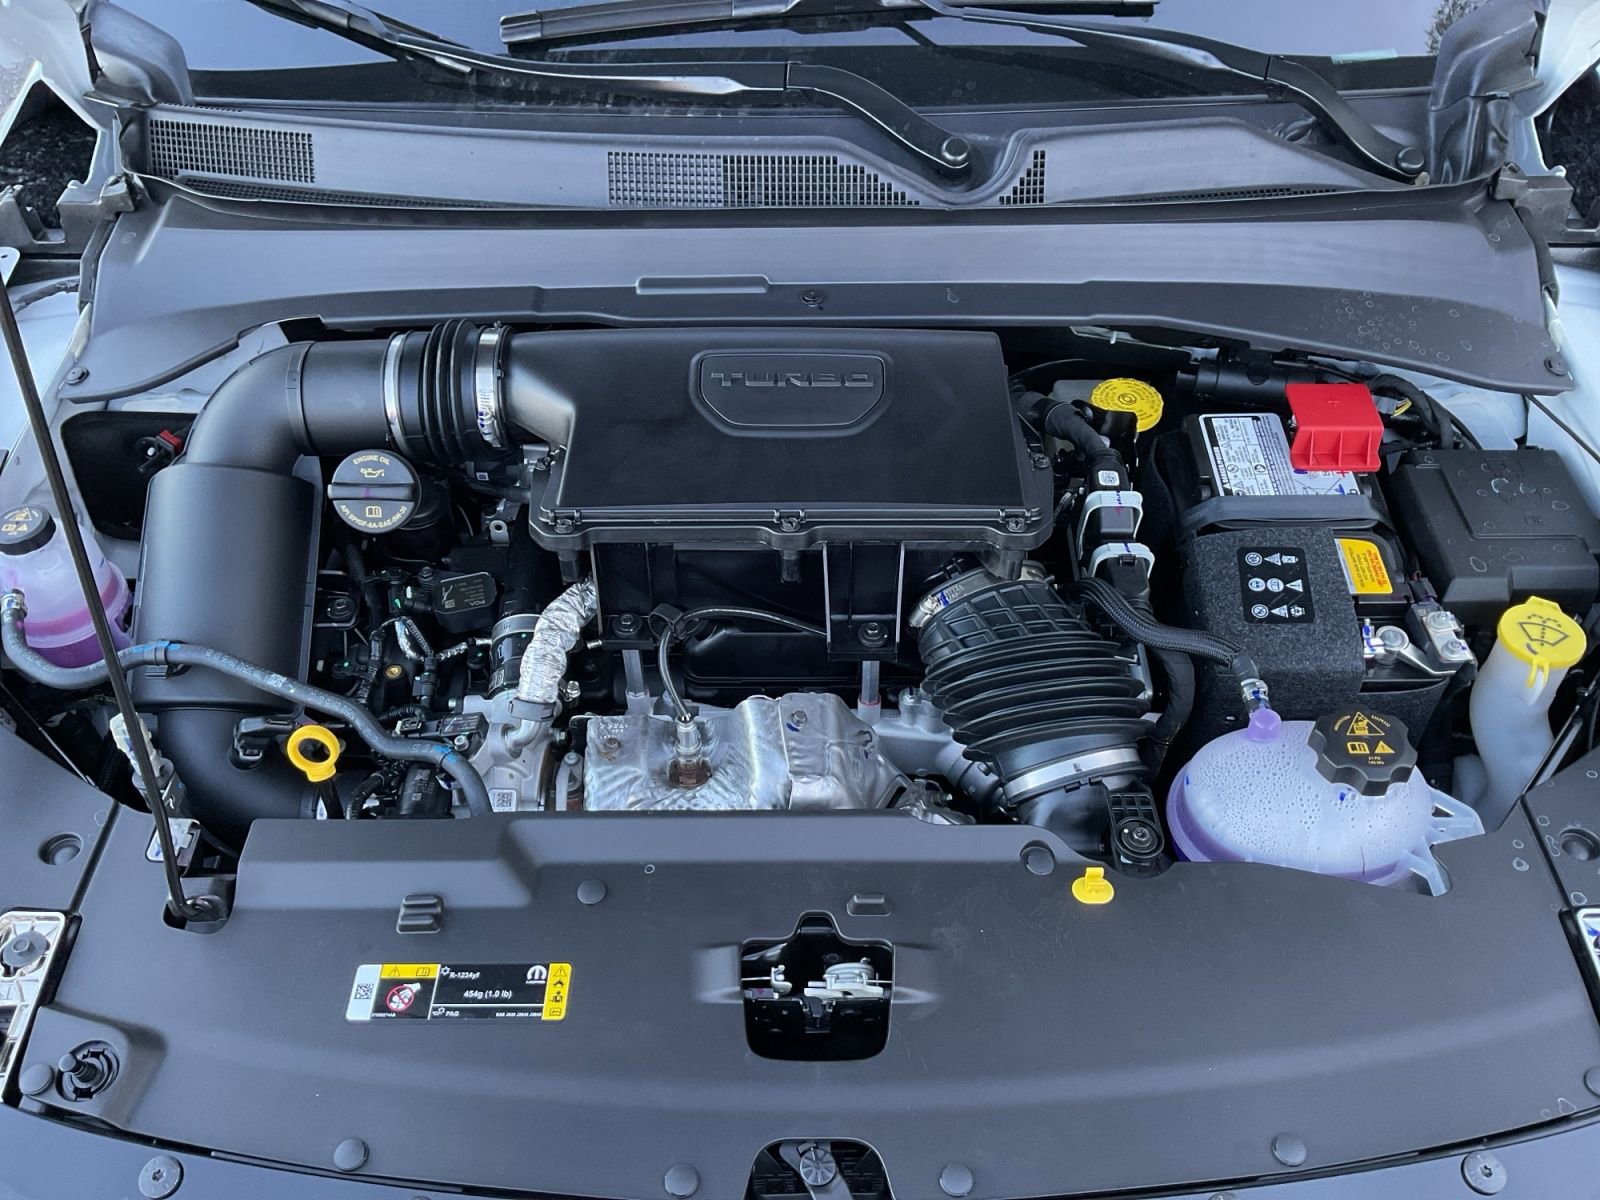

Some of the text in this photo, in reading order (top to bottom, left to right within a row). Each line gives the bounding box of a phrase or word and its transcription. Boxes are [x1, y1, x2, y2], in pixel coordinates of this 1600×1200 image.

[711, 372, 874, 387] TURBO
[352, 454, 391, 466] ENGINE OIL
[449, 971, 480, 979] R-1234yf
[463, 990, 512, 999] 454g (1.0 lb)
